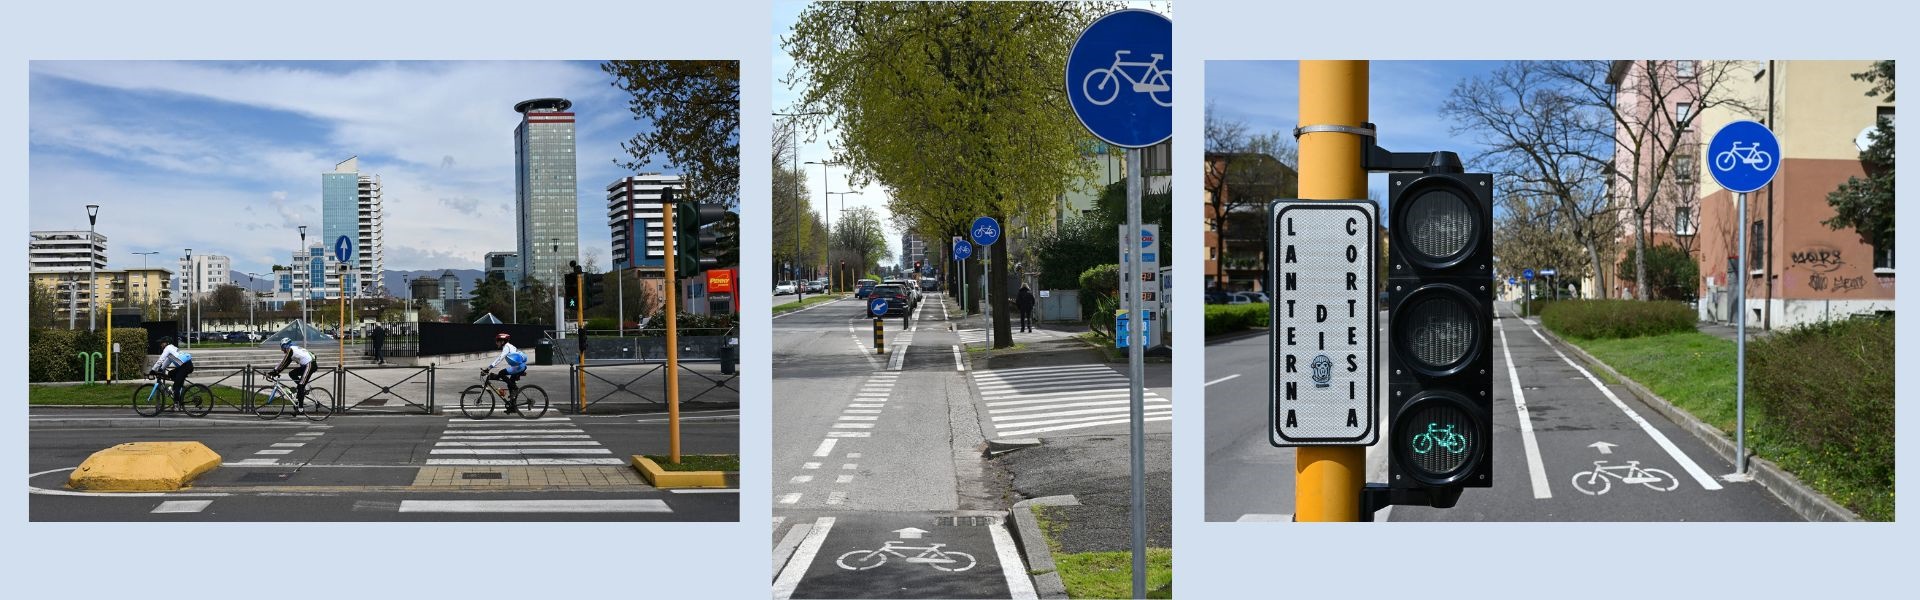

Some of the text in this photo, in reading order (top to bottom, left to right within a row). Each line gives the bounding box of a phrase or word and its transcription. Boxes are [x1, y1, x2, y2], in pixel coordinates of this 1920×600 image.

[1285, 218, 1298, 428] LANTERNA
[1316, 304, 1328, 351] DI
[1345, 217, 1358, 428] CORTESIA
